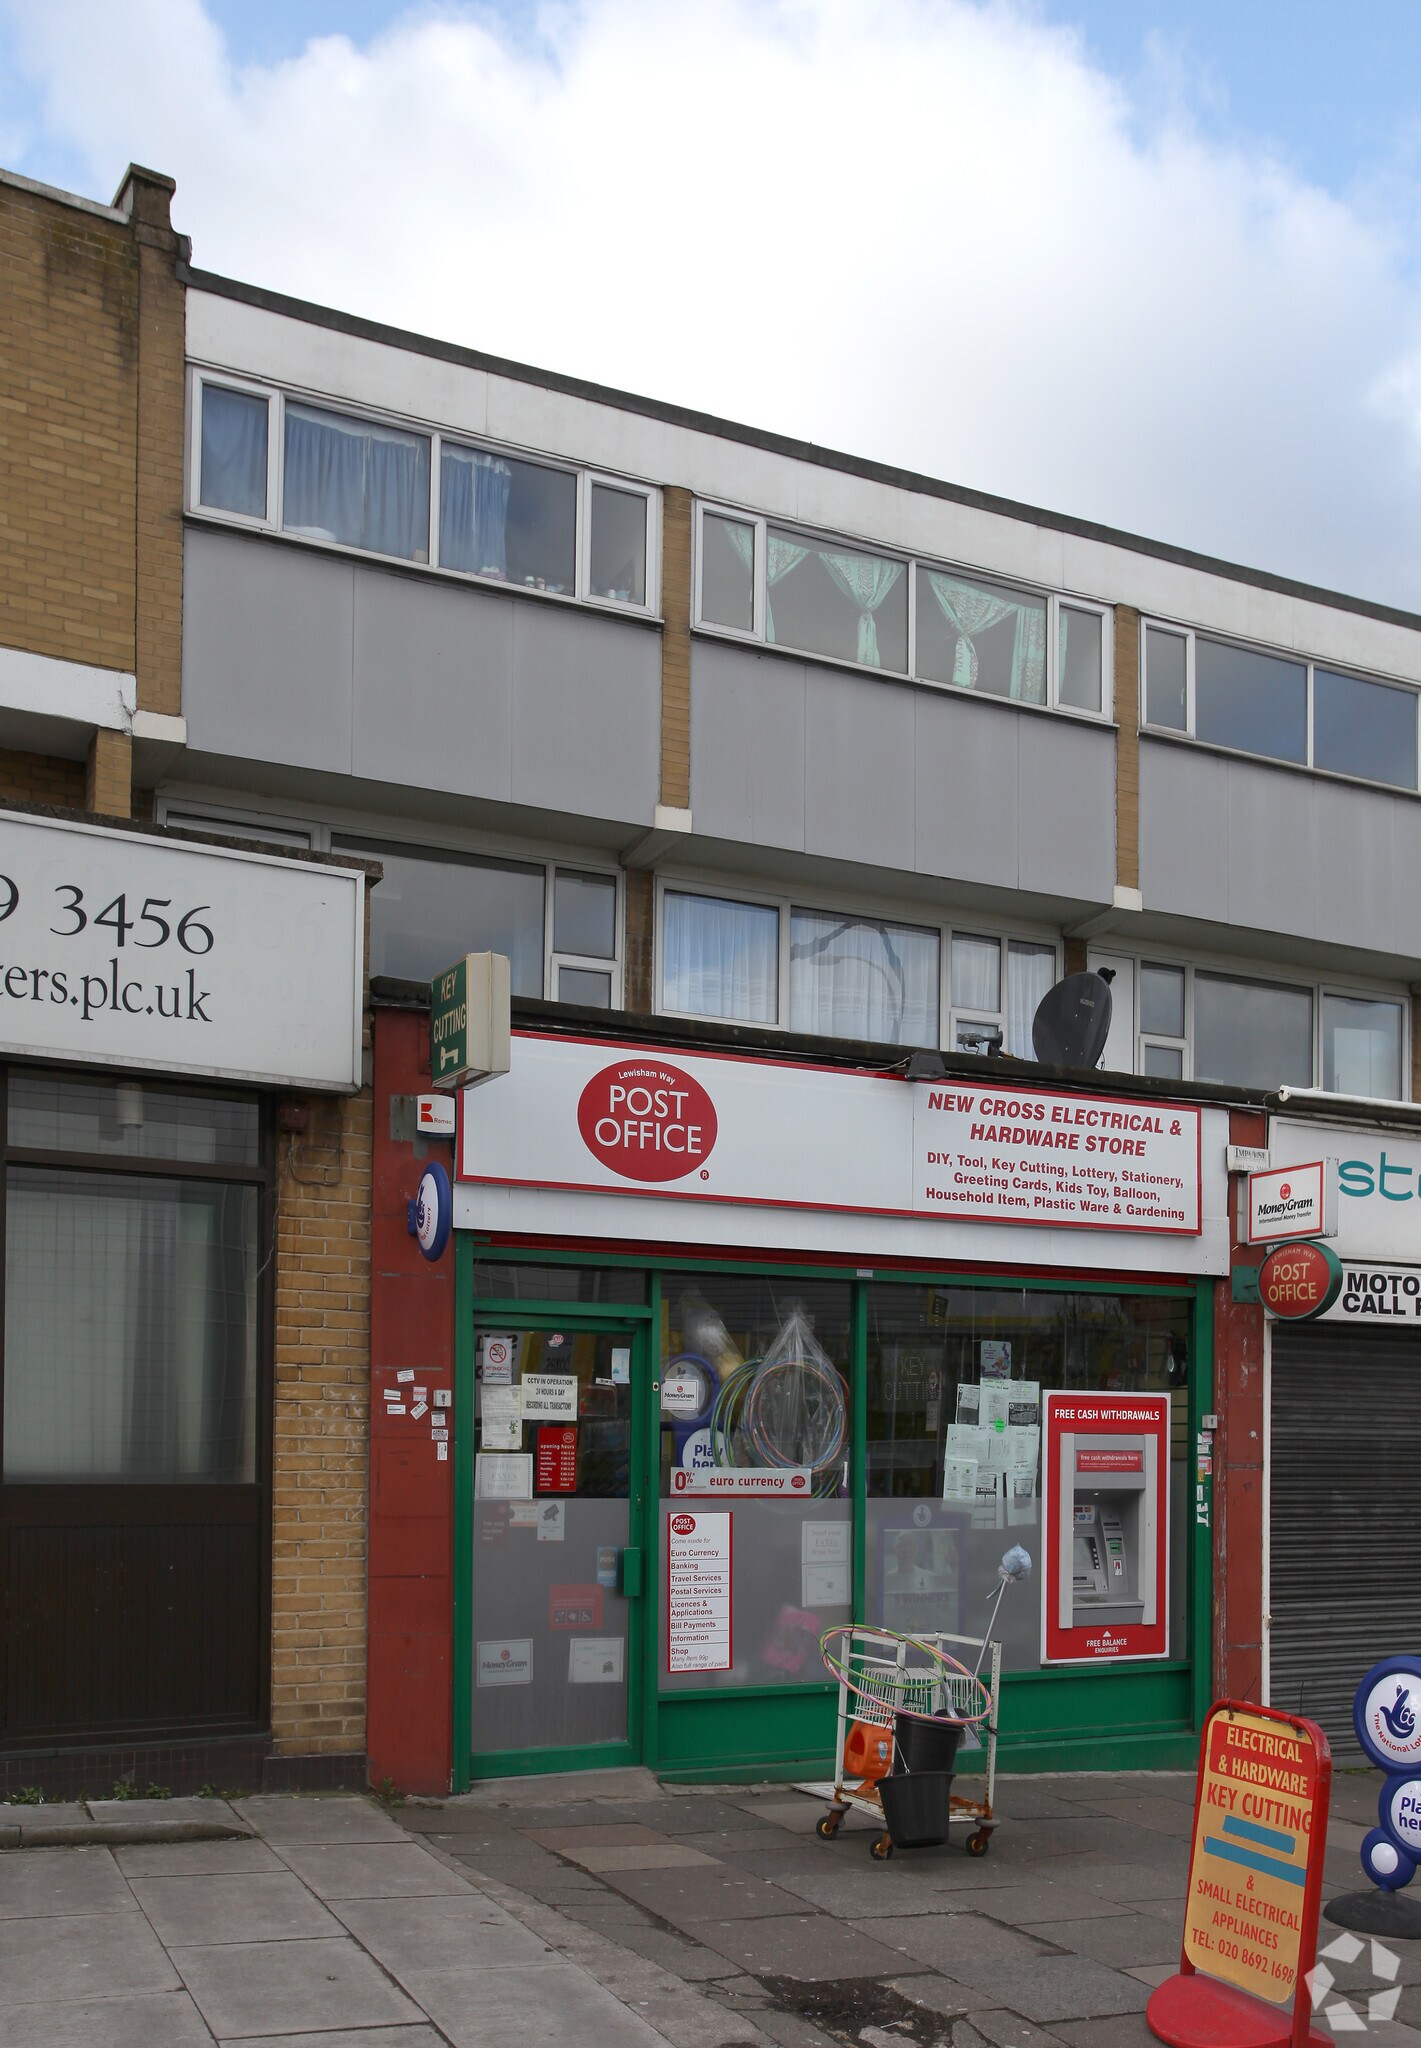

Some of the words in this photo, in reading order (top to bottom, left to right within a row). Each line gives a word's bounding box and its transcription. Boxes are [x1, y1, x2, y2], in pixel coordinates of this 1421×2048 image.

[50, 885, 214, 955] 3456
[0, 958, 213, 1022] ers.plc.uk
[441, 970, 457, 1003] KEY
[434, 1003, 466, 1044] CUTTING
[618, 1069, 657, 1079] Lewisham
[660, 1071, 676, 1085] Way
[610, 1085, 689, 1119] POST
[927, 1092, 975, 1113] NEW
[979, 1097, 1046, 1121] CROSS
[1051, 1106, 1164, 1134] ELECTRICAL
[1169, 1119, 1182, 1136] &
[594, 1117, 702, 1154] OFFICE
[970, 1124, 1080, 1150] HARDWARE
[1085, 1135, 1147, 1157] STORE
[927, 1152, 953, 1168] DIY,
[957, 1155, 987, 1170] Tool,
[992, 1158, 1016, 1173] Key
[1020, 1161, 1068, 1178] Cutting,
[1072, 1166, 1118, 1183] Lottery,
[1121, 1170, 1184, 1188] Stationery,
[953, 1172, 1009, 1190] Greeting
[1012, 1176, 1052, 1193] Cards,
[1056, 1181, 1083, 1195] Kids
[1086, 1183, 1109, 1198] Toy,
[1113, 1187, 1161, 1203] Balloon,
[926, 1187, 994, 1204] Household
[998, 1193, 1029, 1209] Item,
[1034, 1196, 1076, 1211] Plastic
[1080, 1200, 1109, 1213] Ware
[1113, 1202, 1122, 1215] &
[1126, 1203, 1185, 1221] Gardening
[1257, 1198, 1313, 1216] MoneyGram
[1271, 1248, 1302, 1264] LEWISHAM
[1303, 1249, 1316, 1260] WAY
[1272, 1262, 1311, 1282] POST
[1268, 1282, 1318, 1302] OFFICE
[1342, 1293, 1406, 1316] CALL
[541, 1388, 554, 1396] HOURS
[546, 1378, 574, 1386] OPERATION
[1054, 1408, 1075, 1419] FREE
[1077, 1409, 1099, 1420] CASH
[1100, 1409, 1160, 1421] WITHDRAWALS
[709, 1476, 734, 1487] euro
[738, 1476, 785, 1488] currency
[671, 1549, 687, 1557] Euro
[688, 1549, 720, 1557] Currency
[671, 1562, 699, 1571] Banking
[671, 1575, 692, 1583] Travel
[692, 1574, 722, 1582] Services
[670, 1587, 692, 1595] Postal
[693, 1586, 722, 1594] Services
[670, 1600, 701, 1609] Licences
[671, 1608, 713, 1618] Applications
[670, 1621, 682, 1630] Bill
[683, 1621, 716, 1630] Payments
[670, 1634, 709, 1643] Information
[1086, 1639, 1100, 1647] FREE
[1101, 1638, 1127, 1647] BALANCE
[482, 1660, 528, 1669] MoneyGram
[1226, 1726, 1303, 1764] ELECTRICAL
[1377, 1731, 1409, 1753] National
[1218, 1753, 1228, 1774] &
[1231, 1757, 1308, 1796] HARDWARE
[1206, 1782, 1238, 1812] KEY
[1241, 1792, 1313, 1834] CUTTING
[1398, 1813, 1421, 1831] he
[1246, 1874, 1255, 1891] &
[1196, 1878, 1232, 1908] SMALL
[1235, 1892, 1300, 1932] ELECTRICAL
[1212, 1910, 1279, 1950] APPLIANCES
[1191, 1927, 1215, 1953] TEL:
[1218, 1941, 1239, 1963] 020
[1241, 1949, 1269, 1975] 8692
[1270, 1959, 1296, 1985] 1698
